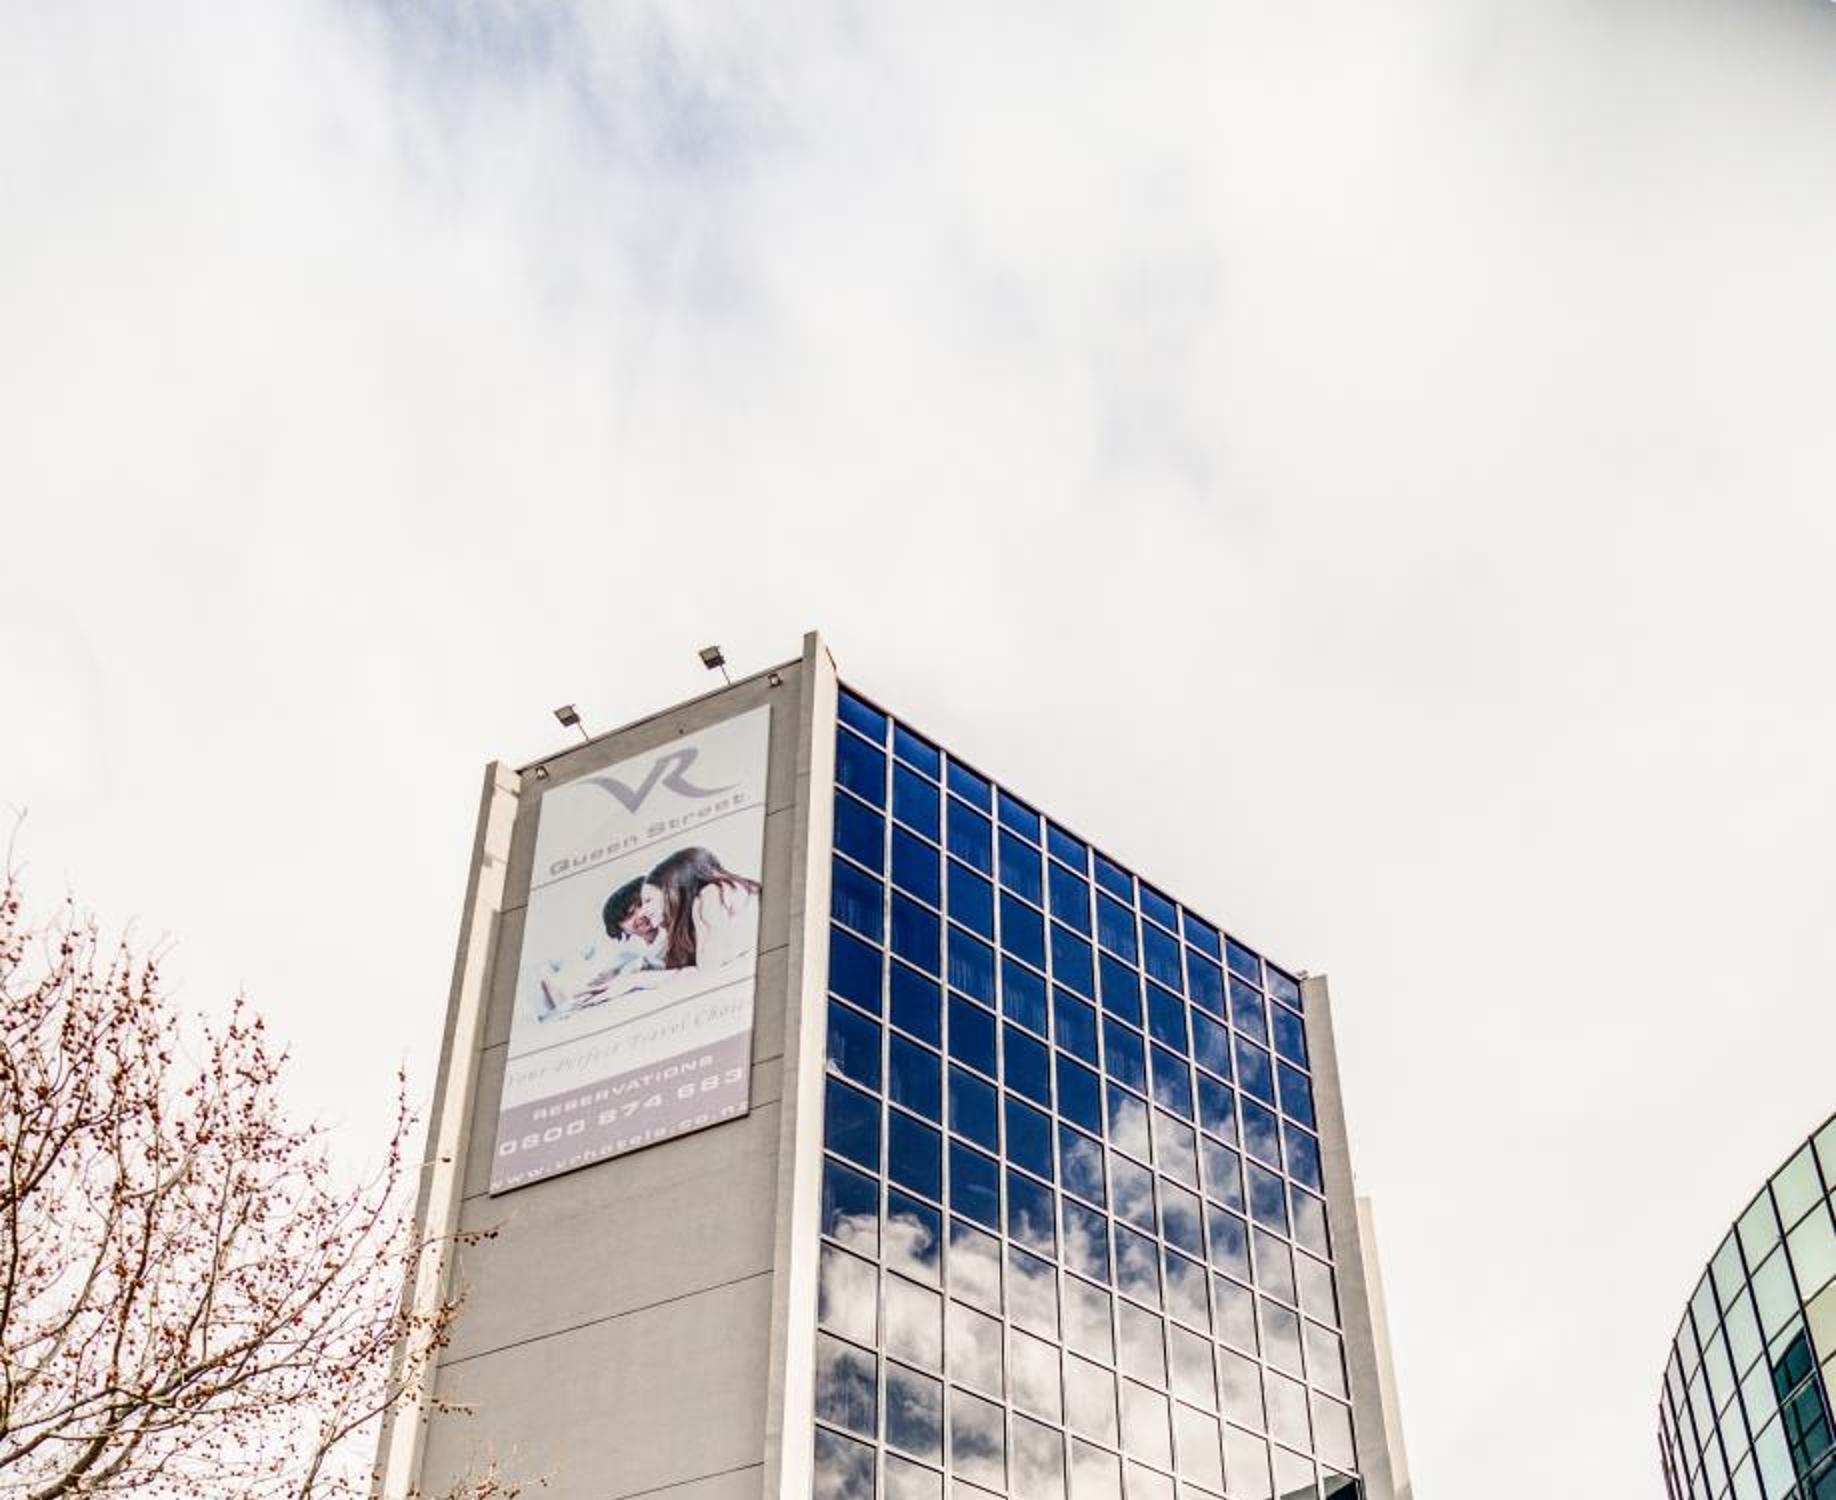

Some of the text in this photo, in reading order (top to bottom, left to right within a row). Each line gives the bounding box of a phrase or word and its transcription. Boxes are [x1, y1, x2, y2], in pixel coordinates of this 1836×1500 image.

[550, 792, 747, 876] Queen Street
[532, 1055, 714, 1121] RESERVATIONS
[597, 1093, 663, 1126] 874
